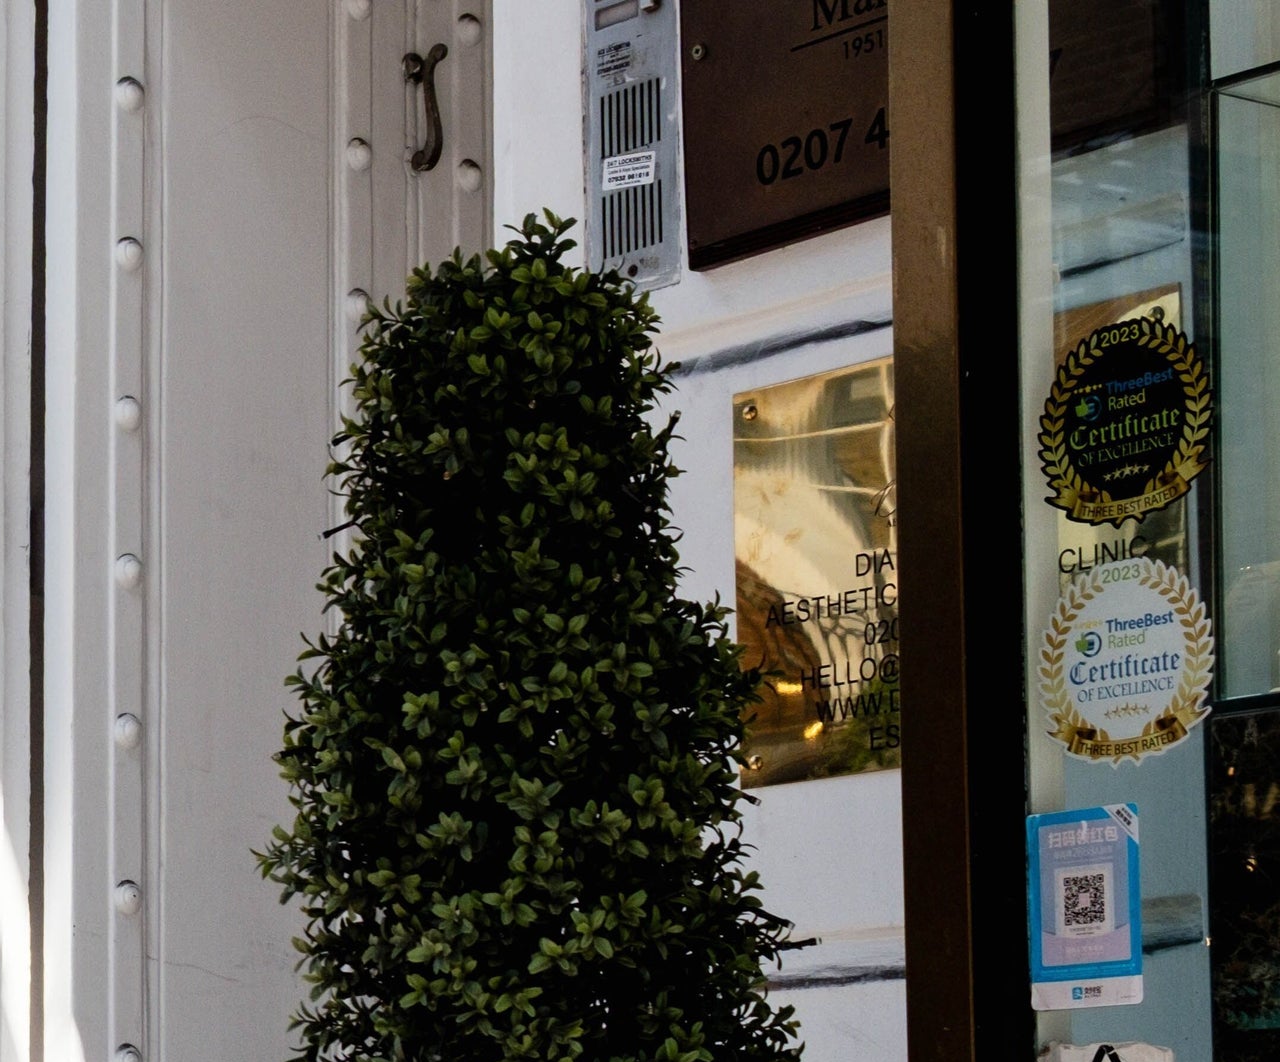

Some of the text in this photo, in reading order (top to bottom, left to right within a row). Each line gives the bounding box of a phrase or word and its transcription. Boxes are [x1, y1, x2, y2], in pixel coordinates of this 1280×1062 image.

[843, 30, 884, 60] 1951
[757, 107, 889, 187] 0207 4
[1100, 325, 1140, 348] 2023
[1106, 367, 1174, 394] ThreeBest
[1108, 389, 1146, 411] Rated
[1070, 408, 1180, 450] Certificate
[1078, 432, 1175, 467] OF EXCELLENCE
[1081, 486, 1178, 518] THREE BEST RATED
[856, 548, 894, 577] DIA
[1059, 536, 1147, 574] CLINIC
[1102, 563, 1140, 584] 2023
[864, 618, 899, 646] 020
[1106, 611, 1174, 633] ThreeBest
[1108, 632, 1146, 650] Rated
[801, 654, 899, 690] HELLO@
[1070, 651, 1180, 686] Certificate
[1077, 676, 1174, 703] OF EXCELLENCE
[816, 688, 899, 722] WWW.D
[869, 724, 900, 751] ES
[1079, 731, 1176, 757] THREE BEST RATED
